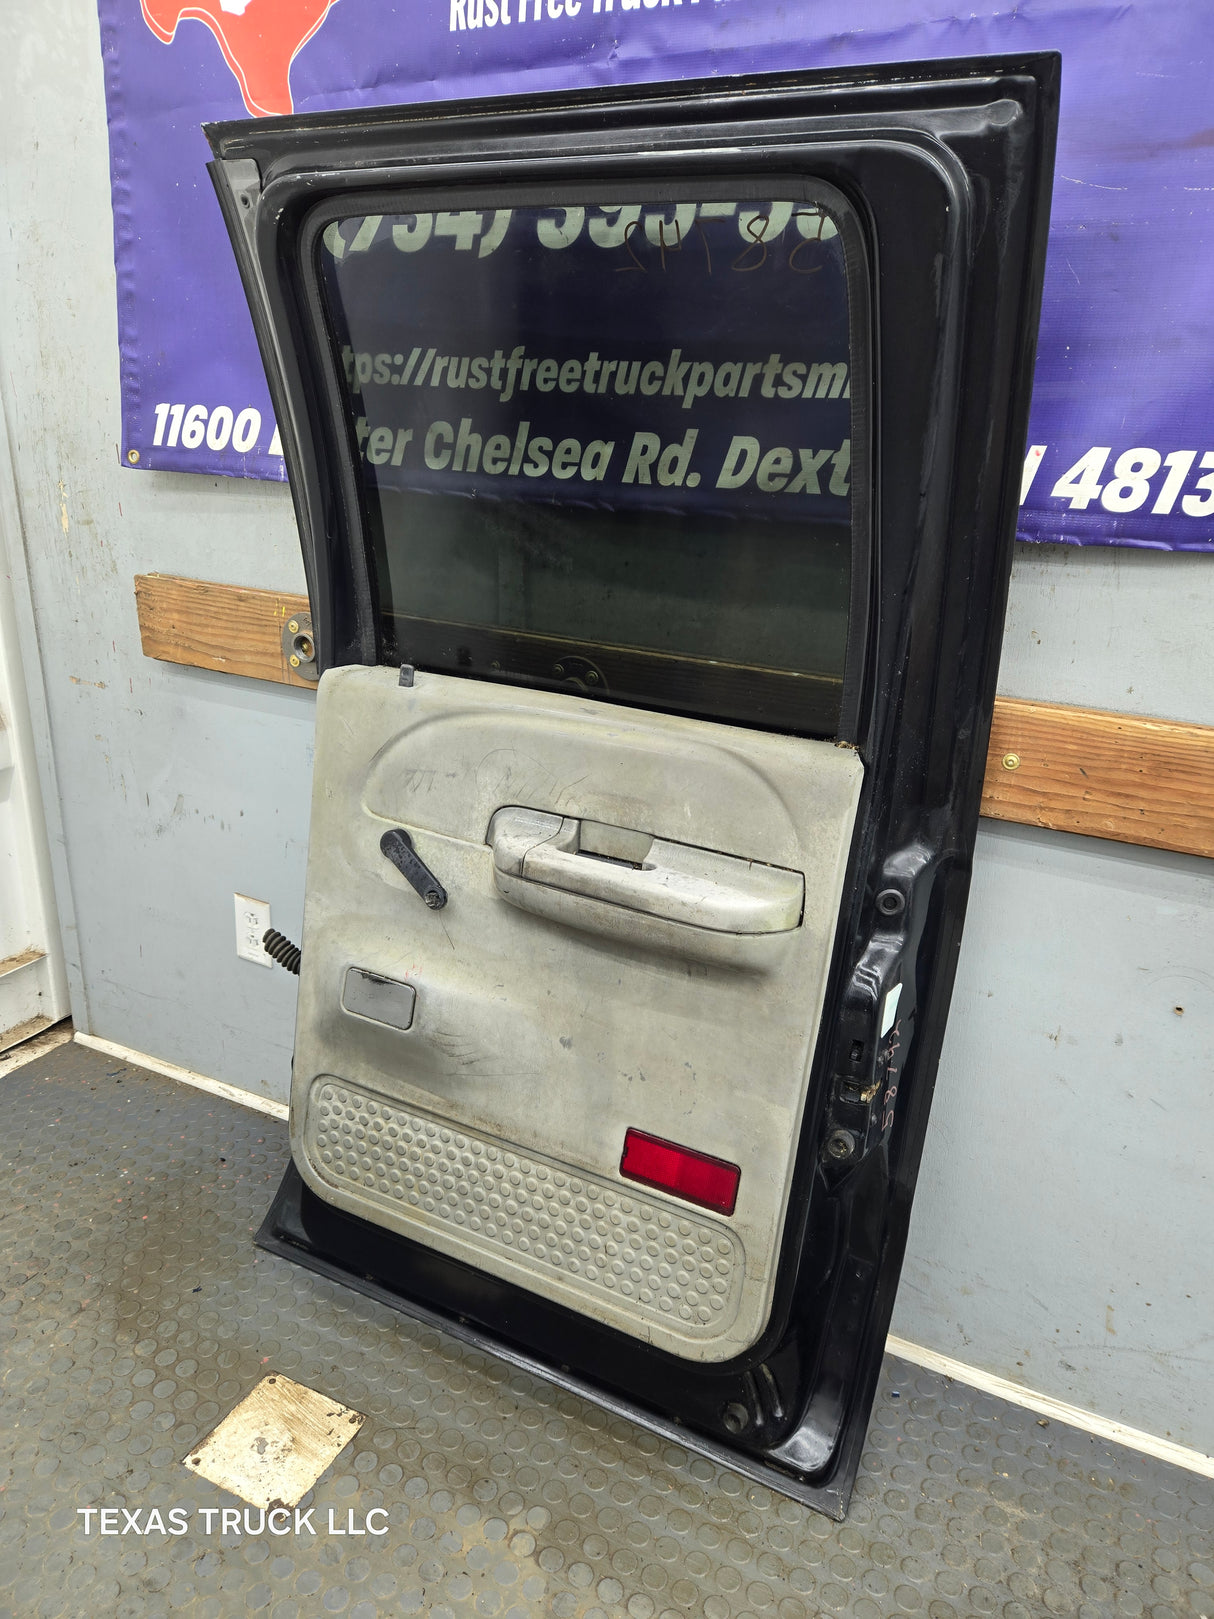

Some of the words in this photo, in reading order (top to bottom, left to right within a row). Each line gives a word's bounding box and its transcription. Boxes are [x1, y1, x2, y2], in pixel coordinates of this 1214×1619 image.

[341, 345, 850, 409] tps://rustfreetruckpartsm
[152, 402, 262, 453] 11600
[424, 417, 616, 481] Chelsea
[621, 428, 702, 488] Rd.
